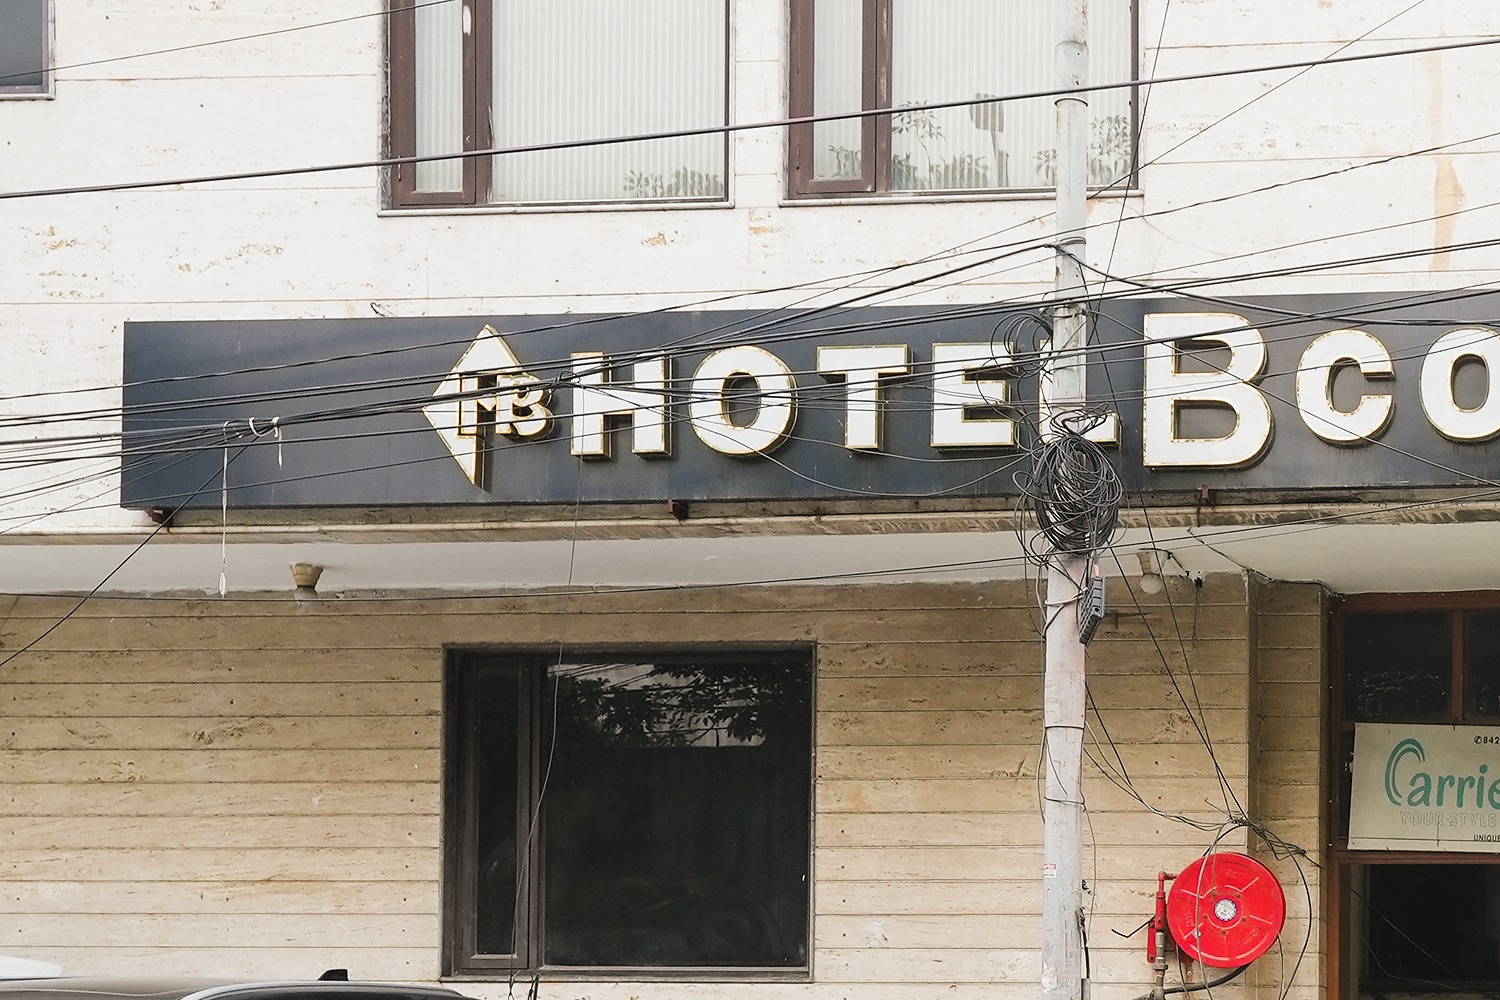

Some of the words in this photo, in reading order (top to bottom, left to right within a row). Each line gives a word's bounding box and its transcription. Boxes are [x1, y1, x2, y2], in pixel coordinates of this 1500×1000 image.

[570, 340, 1118, 458] HOTEL
[1400, 812, 1444, 826] YOUR
[1449, 812, 1497, 828] STYLE
[1474, 834, 1500, 842] UNIQUE
